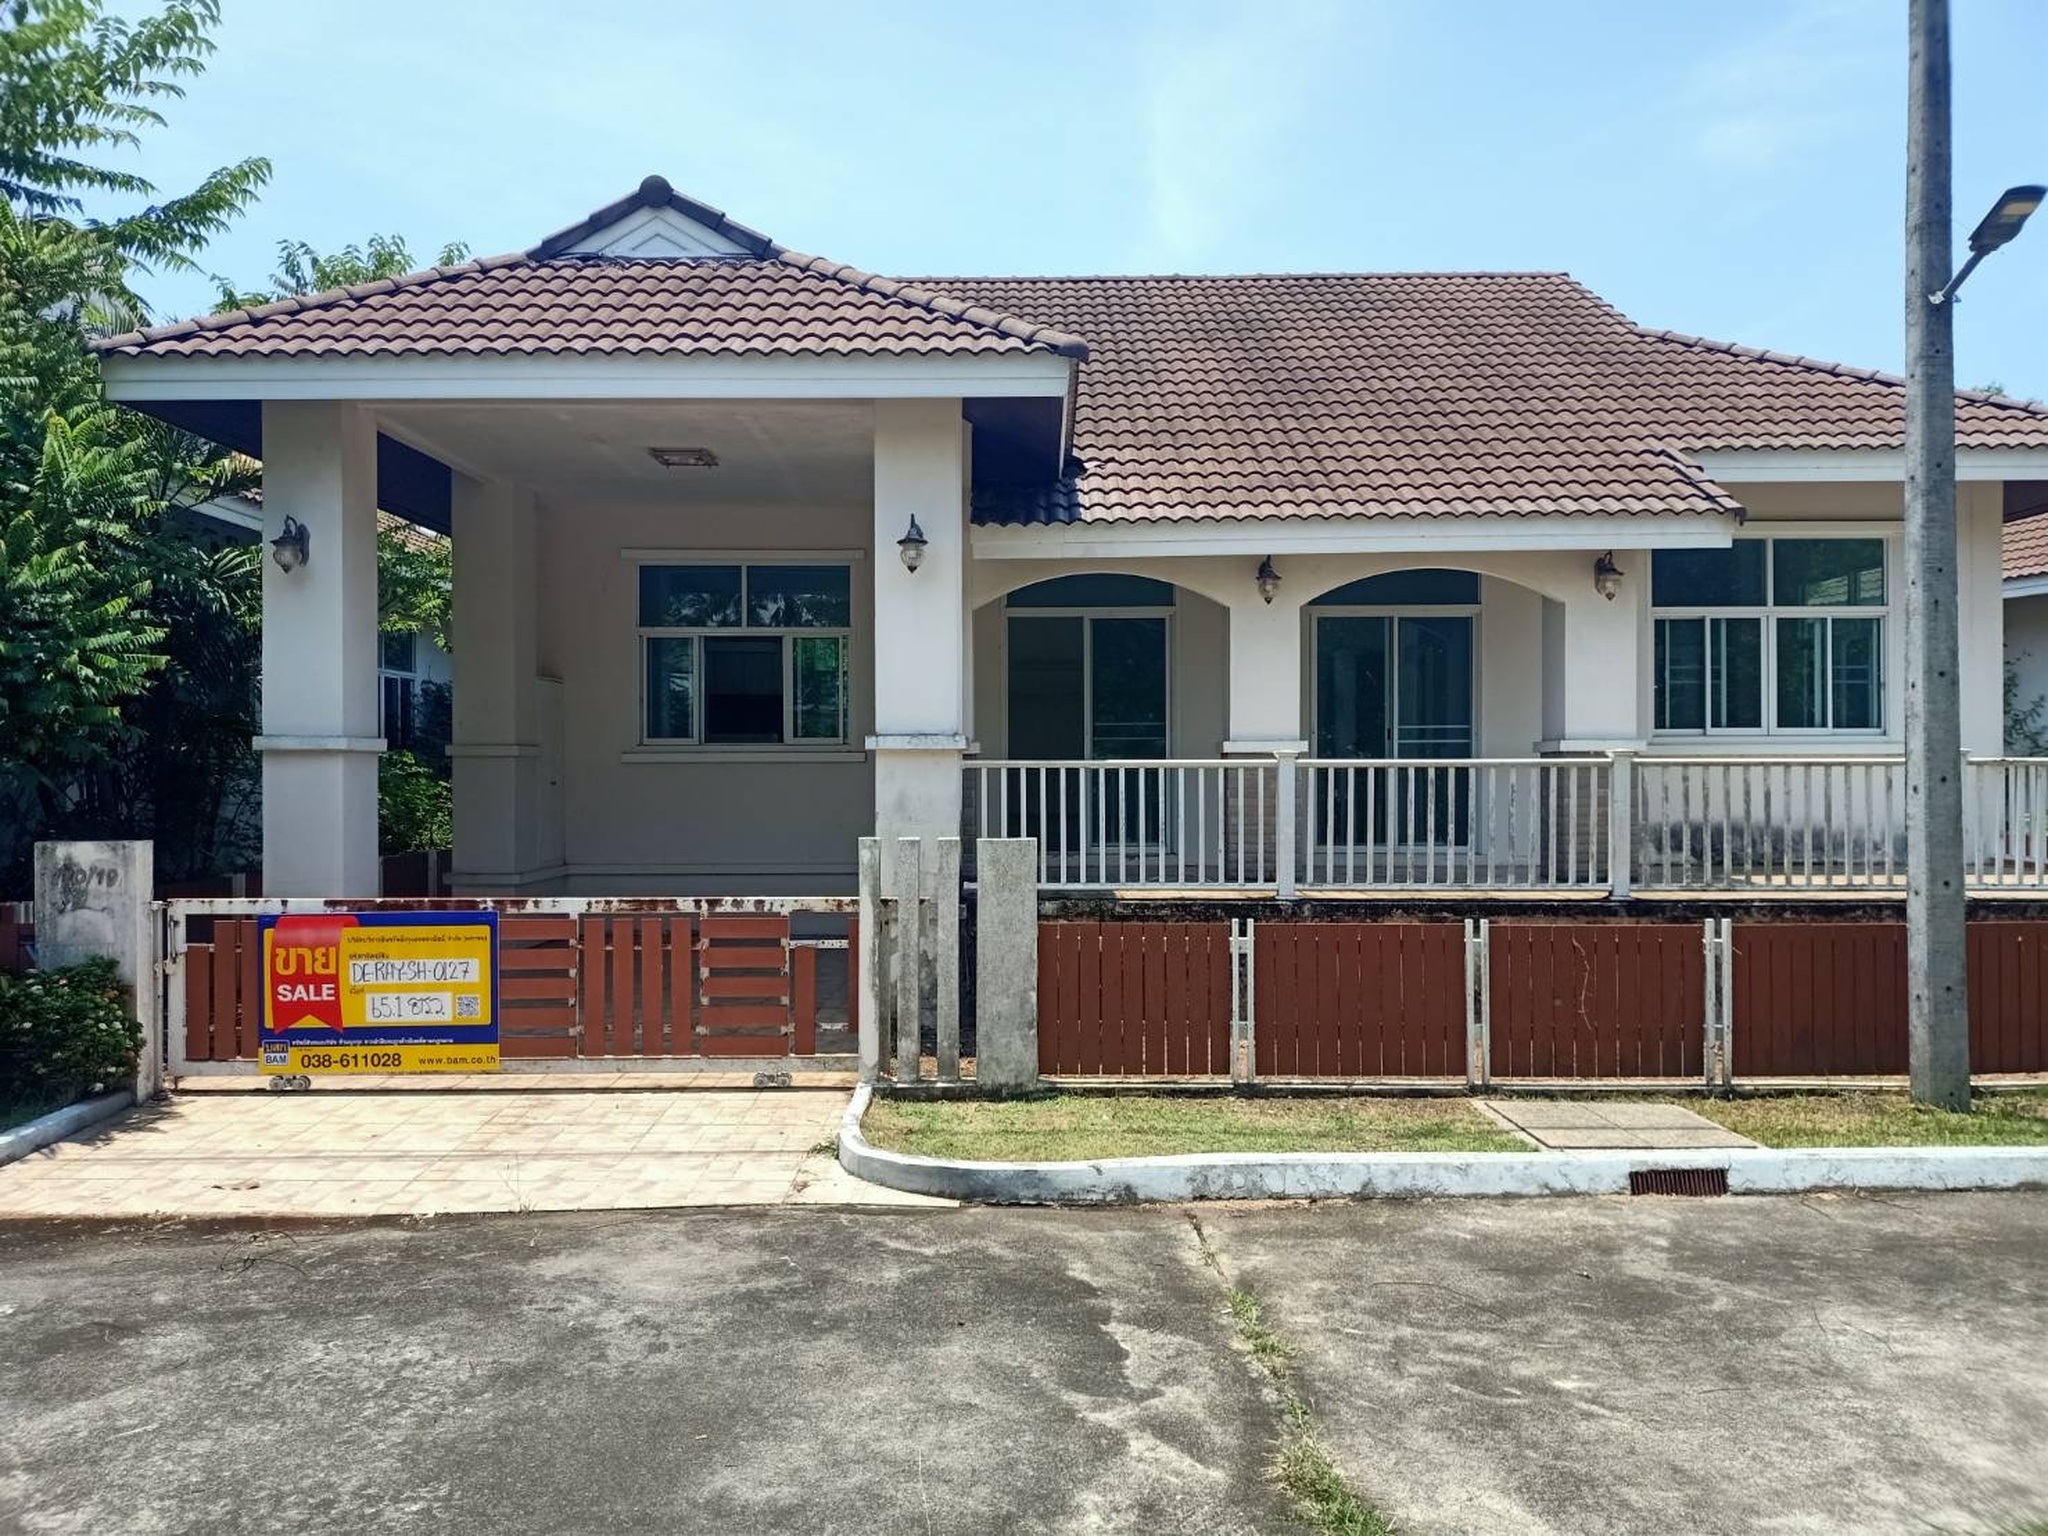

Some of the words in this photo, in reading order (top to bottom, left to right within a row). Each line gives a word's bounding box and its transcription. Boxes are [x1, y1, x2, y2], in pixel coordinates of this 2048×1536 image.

[276, 947, 336, 975] ขาย
[277, 984, 335, 1001] SALE
[371, 996, 402, 1018] 65.1
[265, 1055, 286, 1064] BAM
[301, 1053, 402, 1068] 038-611028
[419, 1055, 496, 1065] www.bam.co.th
